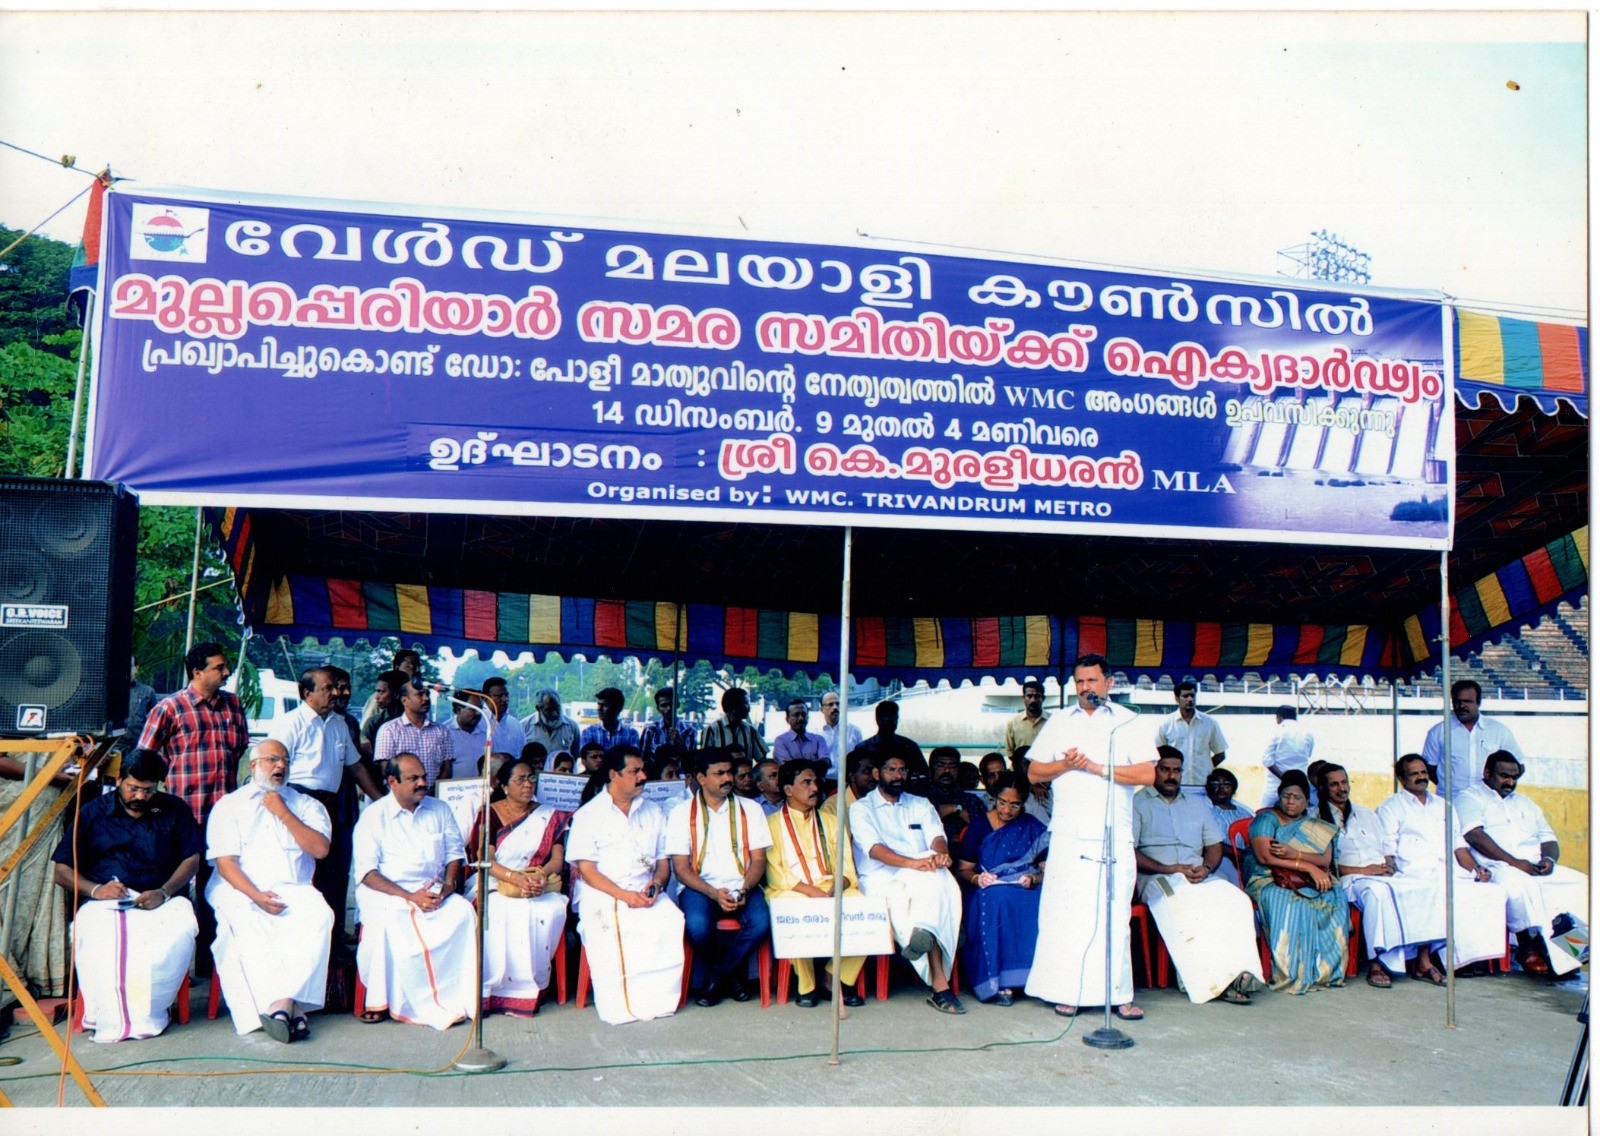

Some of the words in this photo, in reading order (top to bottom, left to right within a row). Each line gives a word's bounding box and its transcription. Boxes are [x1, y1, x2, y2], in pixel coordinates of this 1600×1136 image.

[226, 221, 584, 274] വേൾഡ്
[606, 245, 931, 308] മലയാളി
[969, 275, 1373, 336] കൗൺസിൽ
[109, 273, 562, 340] മുല്ലപ്പെരിയാർ
[577, 300, 741, 350] സമര
[756, 307, 1097, 372] സമിതിയ്ക്ക്
[142, 336, 440, 379] പ്രഖ്യാപിച്ചുകൊണ്ട്
[446, 353, 520, 379] ഡോ:
[631, 361, 796, 404] മാത്യുവിന്റെ
[805, 373, 996, 408] നേതൃത്വത്തിൽ
[1004, 387, 1075, 410] WMC
[1086, 390, 1217, 418] അംഗങ്ങൾ
[1225, 399, 1396, 438] ഉപവസിക്കുന്നു
[593, 401, 624, 424] 14
[636, 402, 803, 434] ഡിസംബർ.
[816, 411, 833, 434] 9
[844, 413, 935, 442] മുതൽ
[945, 419, 962, 440] 4
[973, 418, 1099, 448] മണിവരെ
[430, 431, 663, 471] ഉദ്ഘാടനം
[718, 433, 796, 481] ശ്രീ
[805, 443, 1144, 493] കെ.മുരളീധരൻ
[1154, 470, 1238, 496] MLA
[588, 482, 720, 502] Organised
[730, 485, 771, 507] by:
[786, 490, 854, 507] WMC.
[863, 493, 1025, 513] TRIVANDRUM
[1036, 500, 1112, 517] METRO
